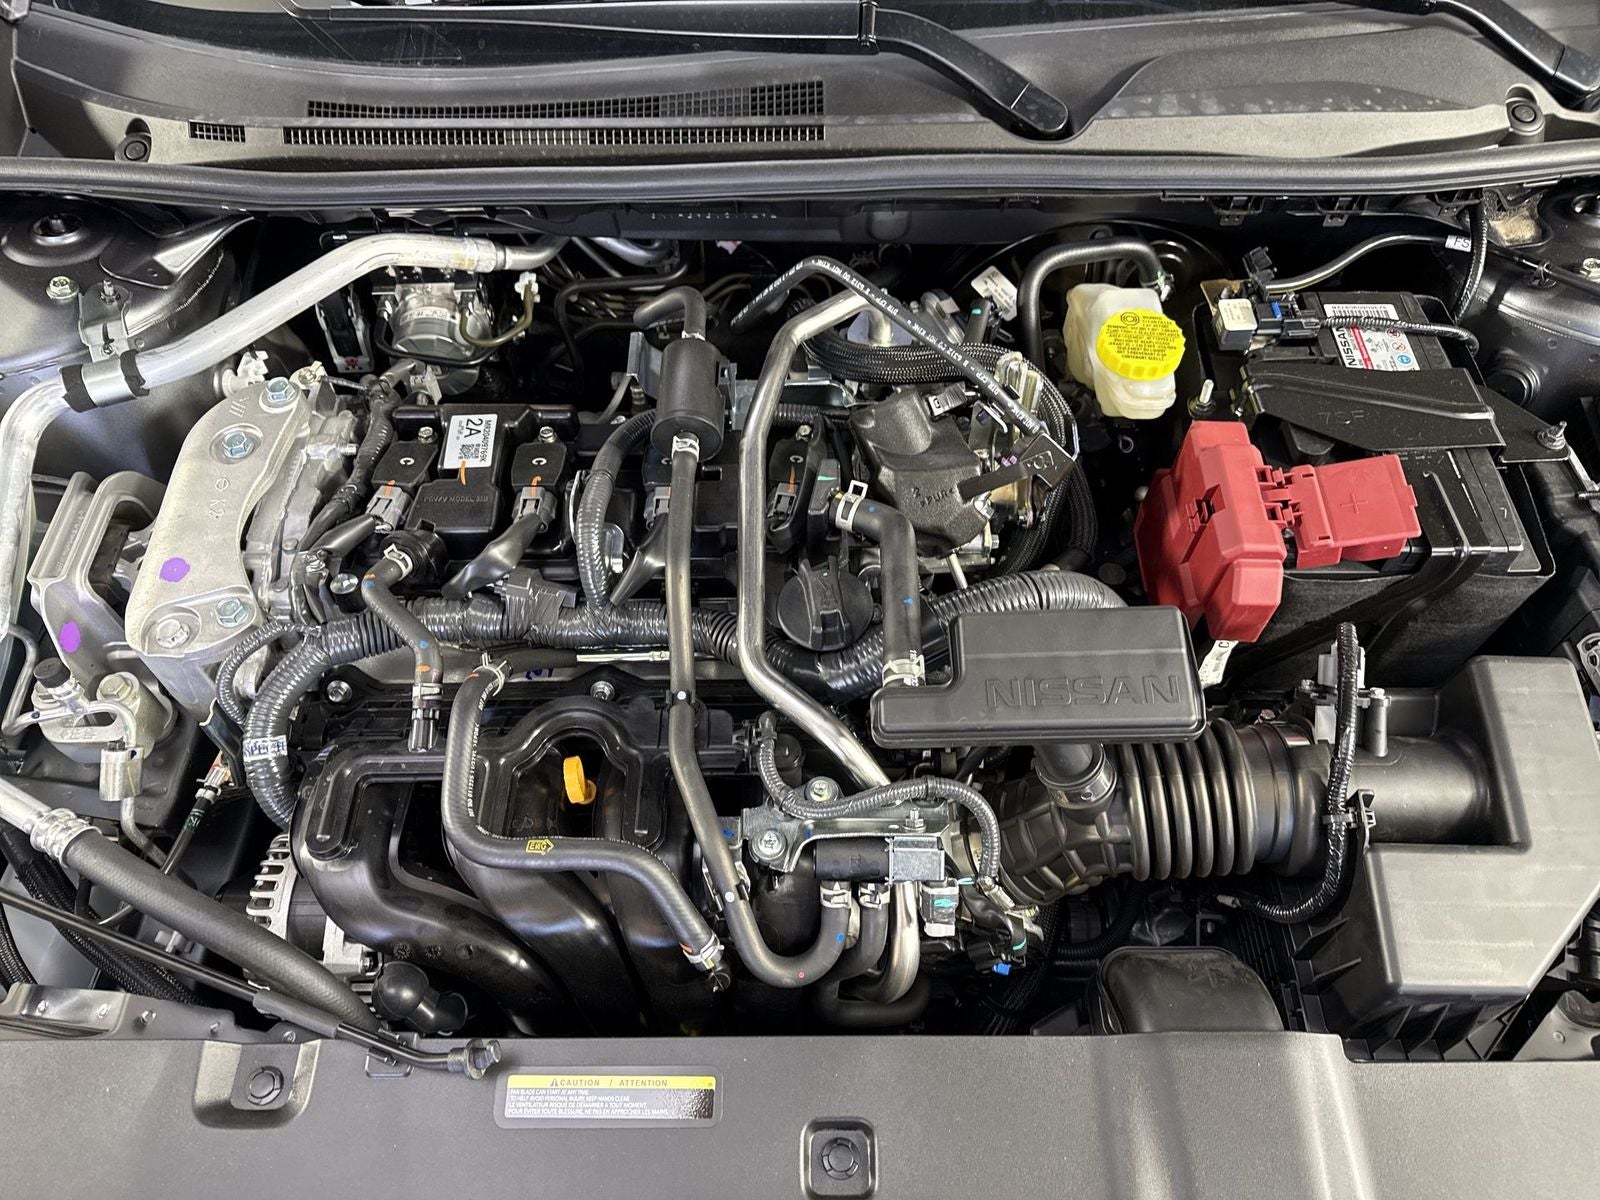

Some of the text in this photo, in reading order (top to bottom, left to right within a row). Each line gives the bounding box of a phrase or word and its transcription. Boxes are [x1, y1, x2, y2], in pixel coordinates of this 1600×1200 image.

[1453, 236, 1470, 248] FS
[912, 322, 927, 338] KINK
[464, 418, 483, 438] 2A
[985, 675, 1182, 708] NISSAN
[529, 840, 548, 850] ENG
[619, 1079, 667, 1087] ATTENTION
